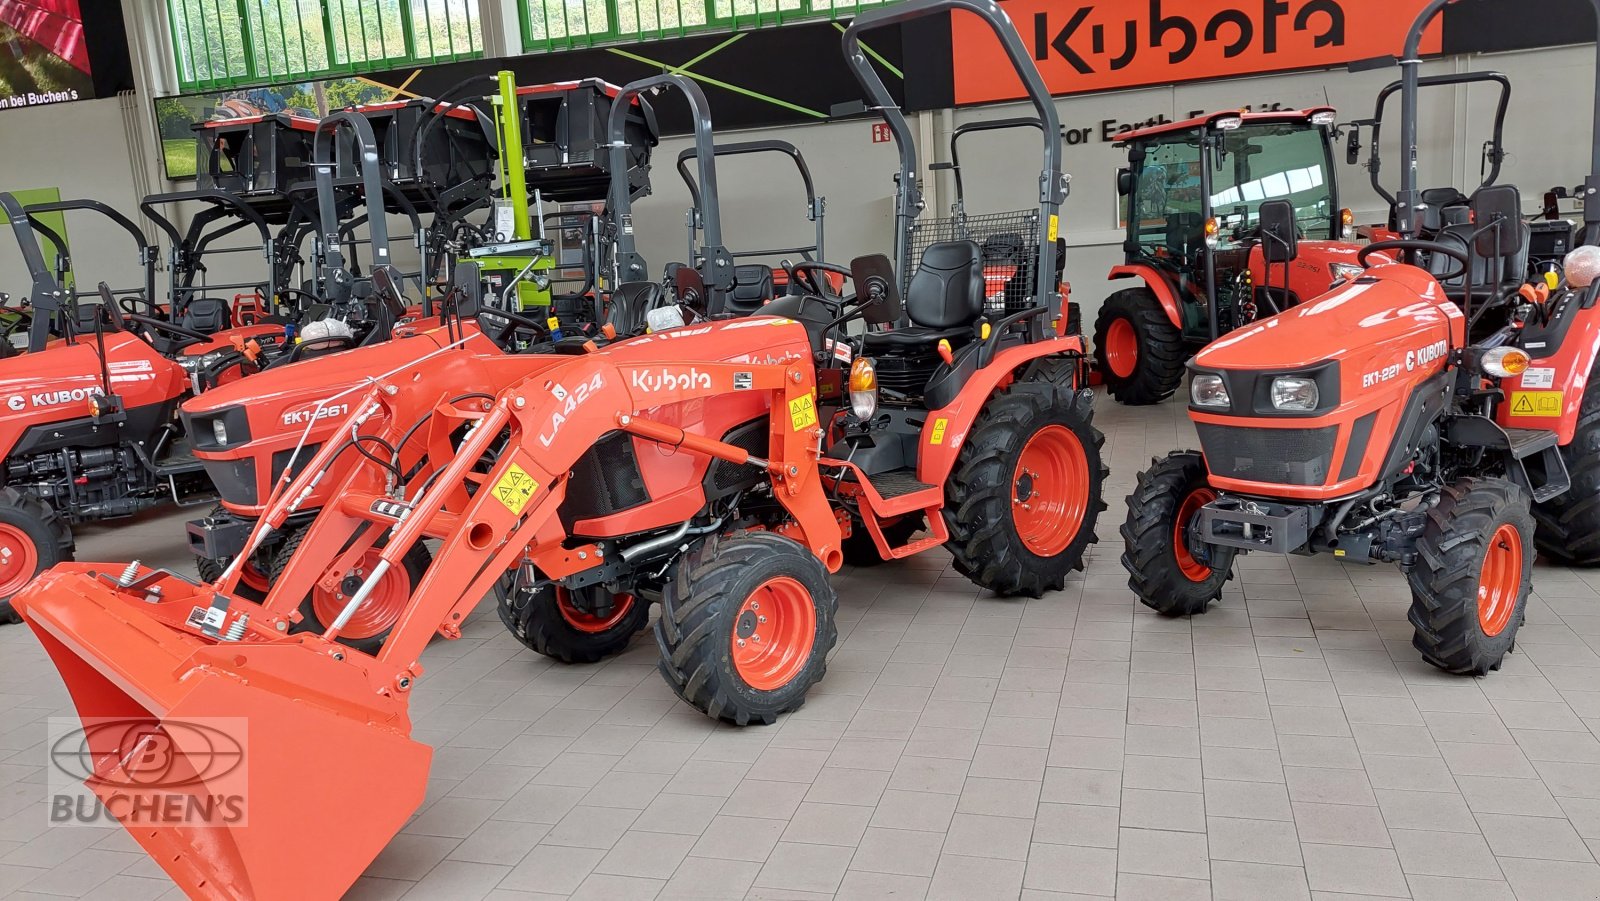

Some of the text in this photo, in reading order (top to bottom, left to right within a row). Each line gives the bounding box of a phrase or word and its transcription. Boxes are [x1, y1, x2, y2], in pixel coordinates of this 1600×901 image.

[1033, 0, 1345, 74] Kubota
[0, 97, 8, 108] n
[10, 93, 26, 107] bei
[1362, 339, 1448, 388] EK1-221 KUBOTA
[632, 367, 711, 392] Kubota
[31, 386, 105, 406] KUBOTA
[283, 403, 348, 425] EK1-261
